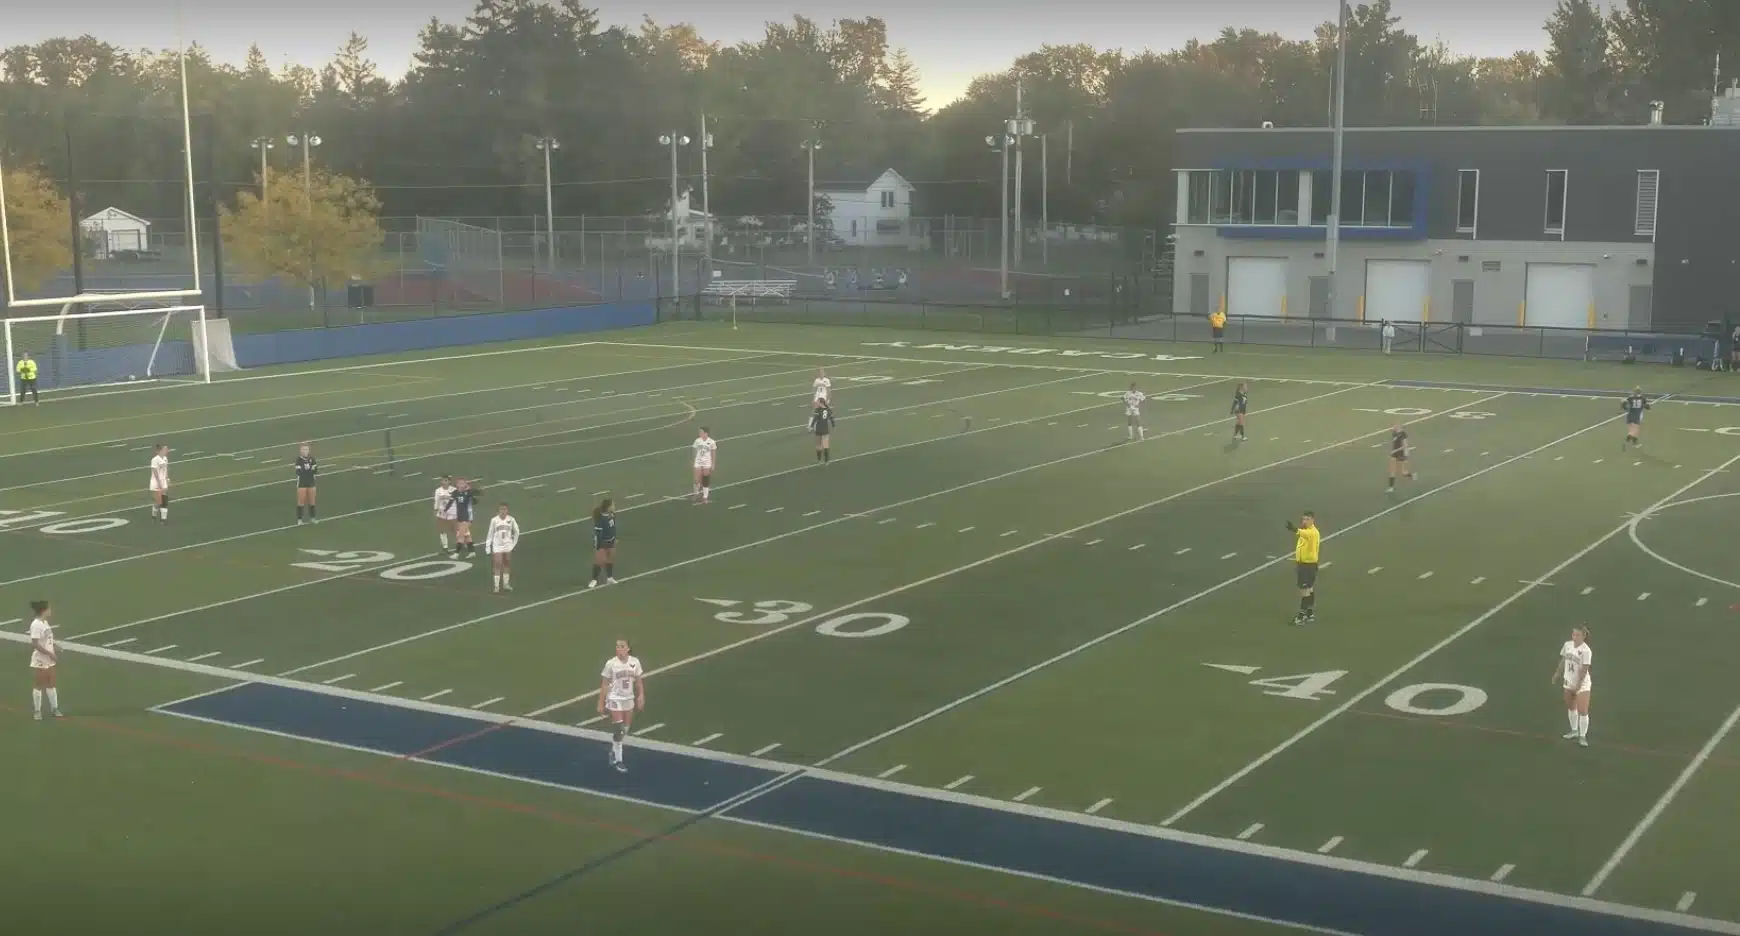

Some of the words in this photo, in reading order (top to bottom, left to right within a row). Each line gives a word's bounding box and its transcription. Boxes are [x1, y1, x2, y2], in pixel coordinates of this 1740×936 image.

[859, 341, 1205, 361] ACADEMY
[289, 550, 473, 580] 20
[714, 600, 910, 638] 30
[1249, 670, 1488, 716] 40
